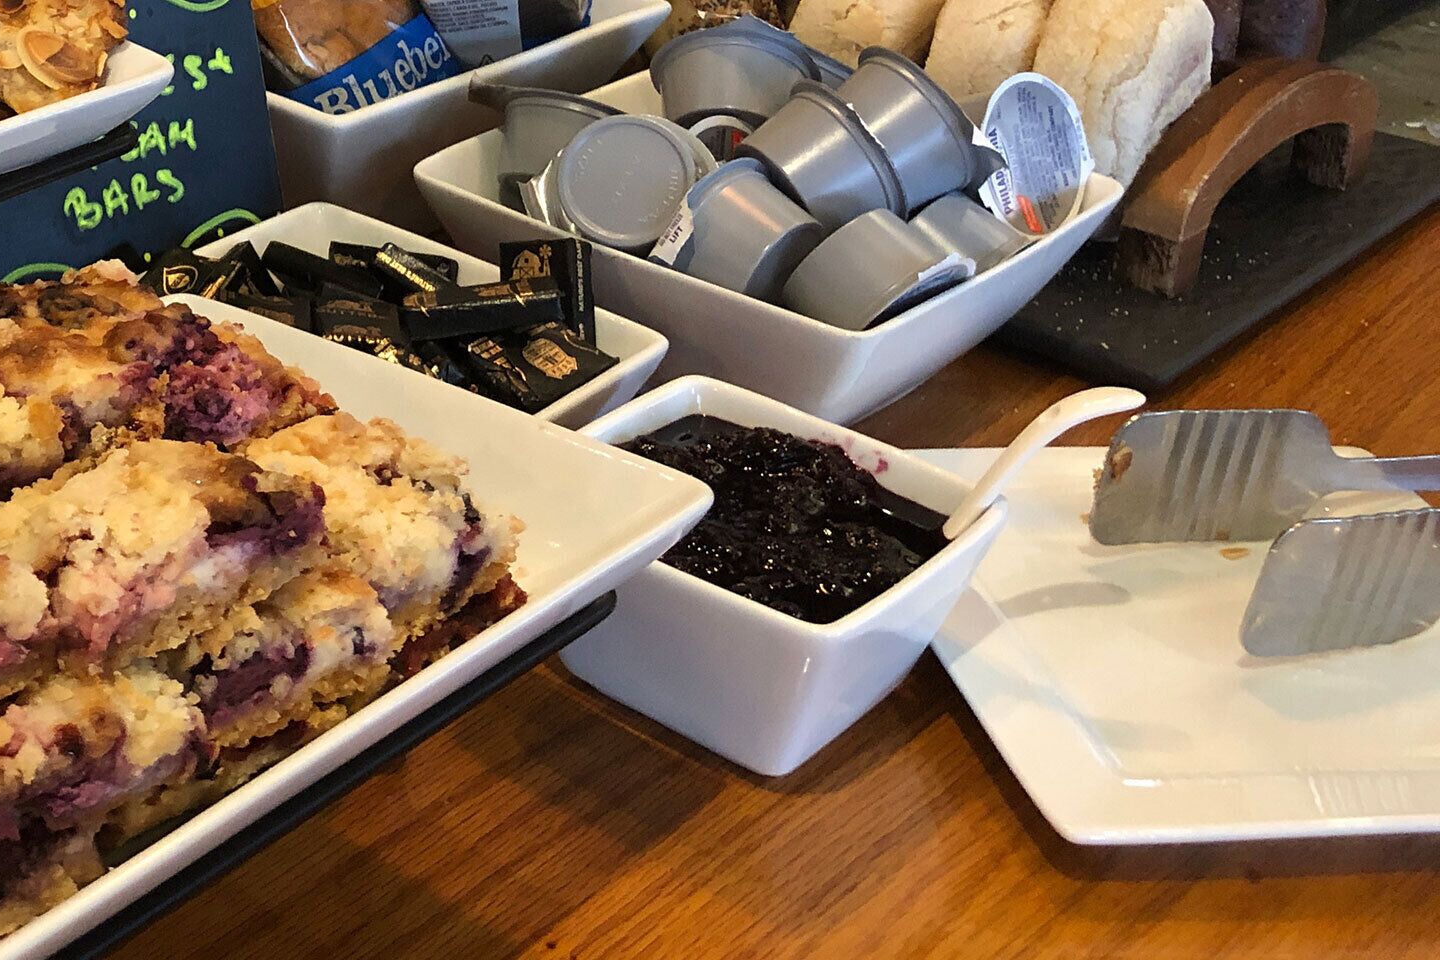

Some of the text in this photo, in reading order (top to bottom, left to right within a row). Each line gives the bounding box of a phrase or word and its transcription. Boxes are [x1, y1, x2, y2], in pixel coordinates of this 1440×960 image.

[63, 168, 185, 231] BARS
[988, 126, 1013, 216] PHILADIA
[668, 225, 684, 244] LIFT
